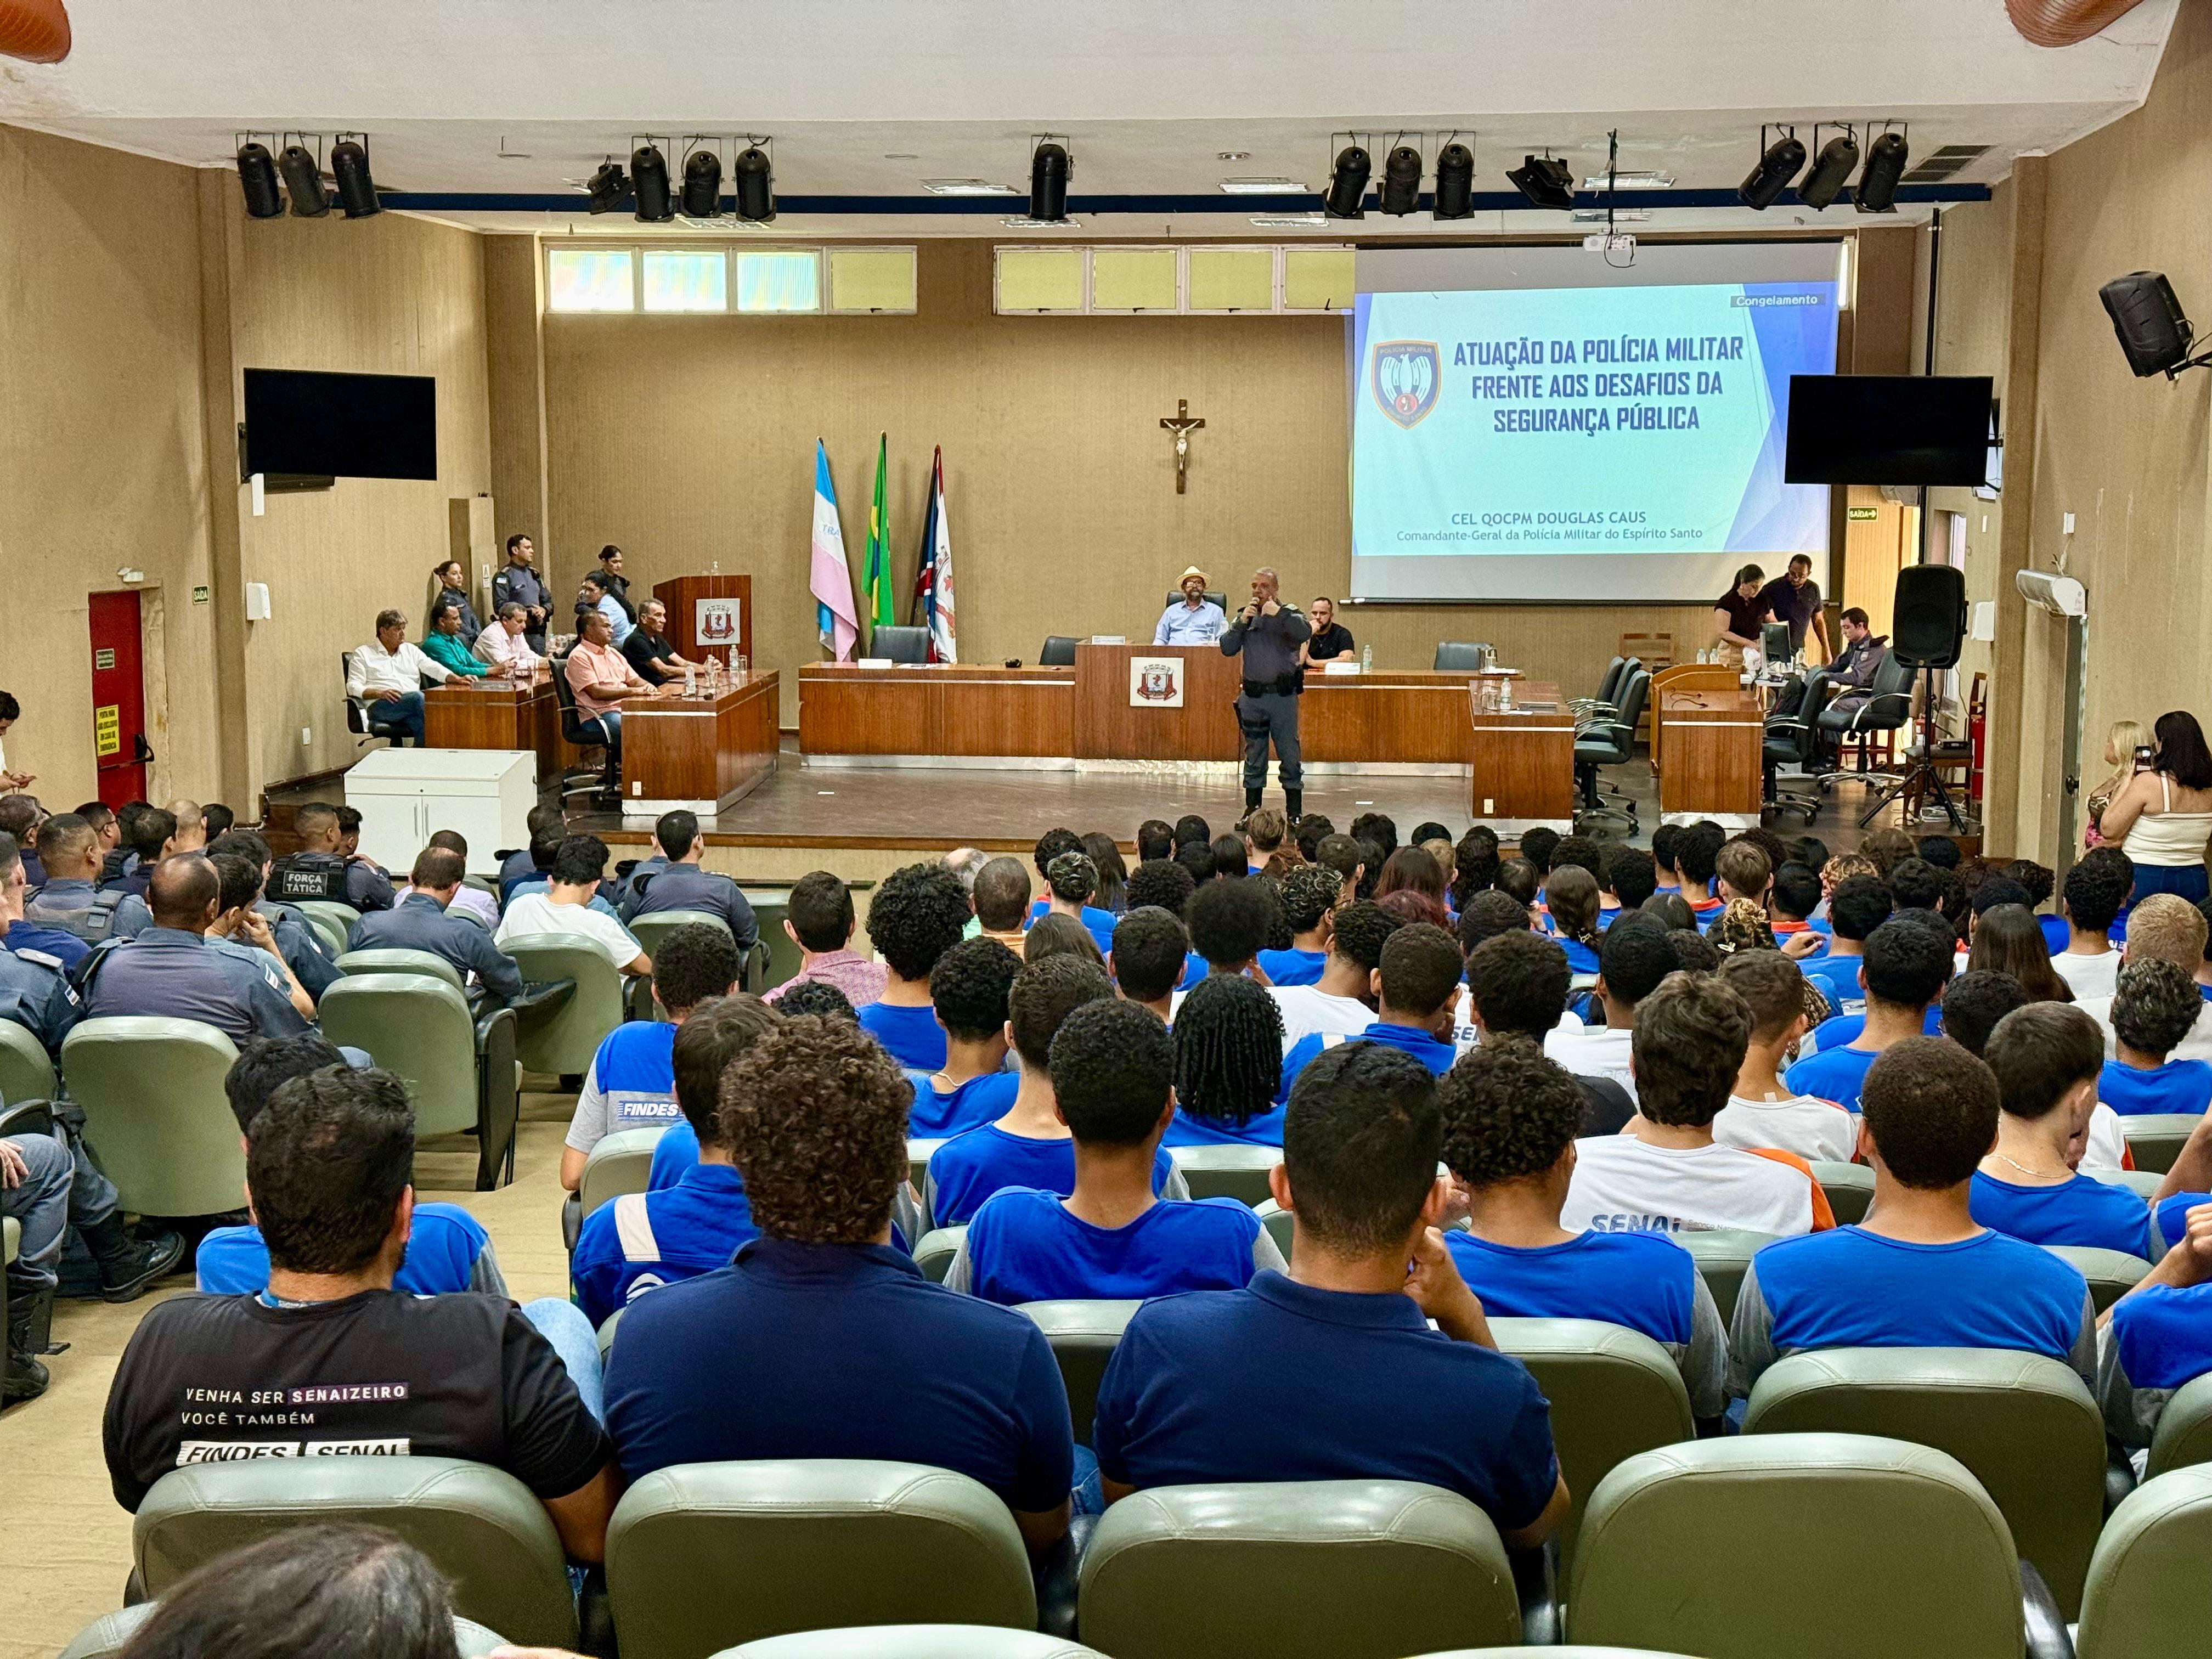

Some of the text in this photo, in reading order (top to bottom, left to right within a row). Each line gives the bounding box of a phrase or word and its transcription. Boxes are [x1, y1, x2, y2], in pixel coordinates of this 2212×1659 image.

[1736, 295, 1818, 307] Congelamento
[1454, 334, 1744, 371] ATUAÇÃO DA POLÍCIA MILITAR
[1472, 371, 1723, 399] FRENTE AOS DESAFIOS DA
[1494, 402, 1700, 437] SEGURANÇA PÚBLICA
[1451, 511, 1646, 526] CEL QOCPM DOUGLAS CAUS
[1849, 509, 1869, 518] SAÍDA
[1397, 528, 1703, 542] Comandante-Geral da Polícia Militar do Espírito Santo
[194, 588, 207, 600] SAÍDA
[289, 873, 323, 884] FORÇA
[286, 882, 323, 893] TÁTICA
[624, 1103, 679, 1116] FINDES
[187, 1385, 405, 1404] VENHA SER SENAIZEIRO
[181, 1411, 315, 1425] VOCÊ TAMBÉM
